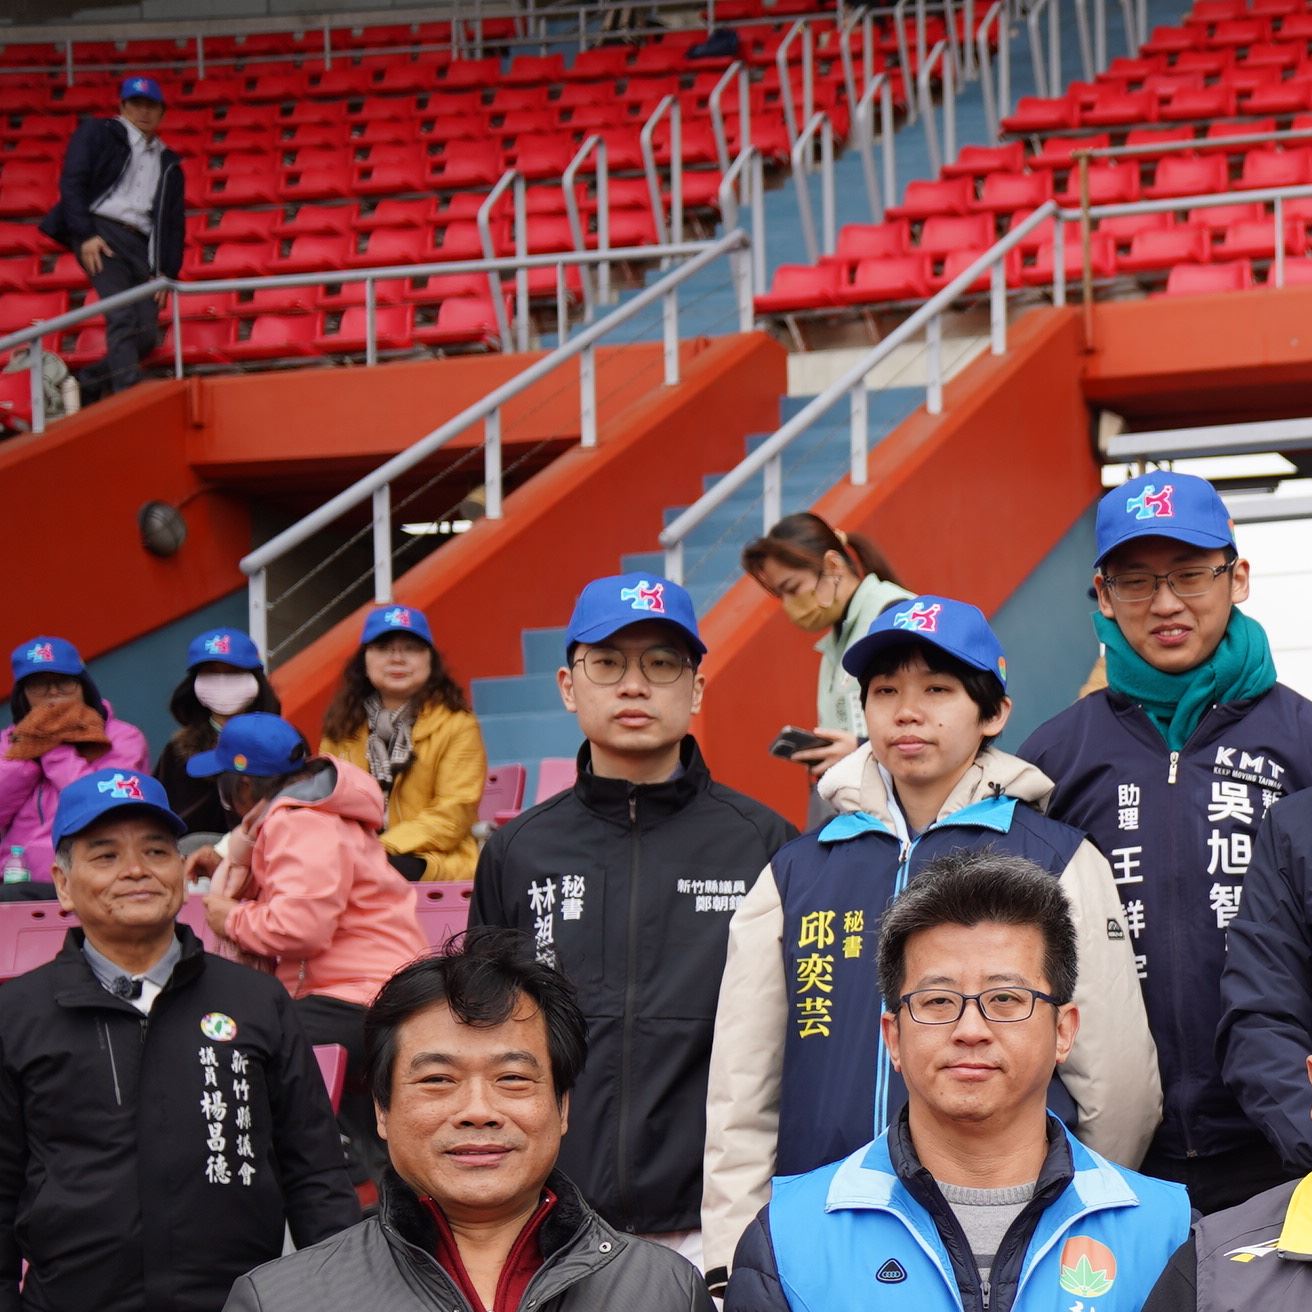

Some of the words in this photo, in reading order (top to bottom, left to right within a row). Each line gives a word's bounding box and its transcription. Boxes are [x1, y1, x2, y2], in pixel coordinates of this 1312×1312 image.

[1213, 766, 1231, 776] KEEP
[1232, 769, 1257, 782] MOVING
[1258, 775, 1282, 790] TAIWAN
[1215, 746, 1285, 780] KMT
[1118, 783, 1140, 830] 助理
[561, 874, 586, 921] 秘書
[677, 878, 746, 894] 新竹縣議員
[842, 909, 865, 959] 秘書
[796, 908, 836, 1039] 邱奕芸
[231, 1049, 256, 1187] 新竹縣議會
